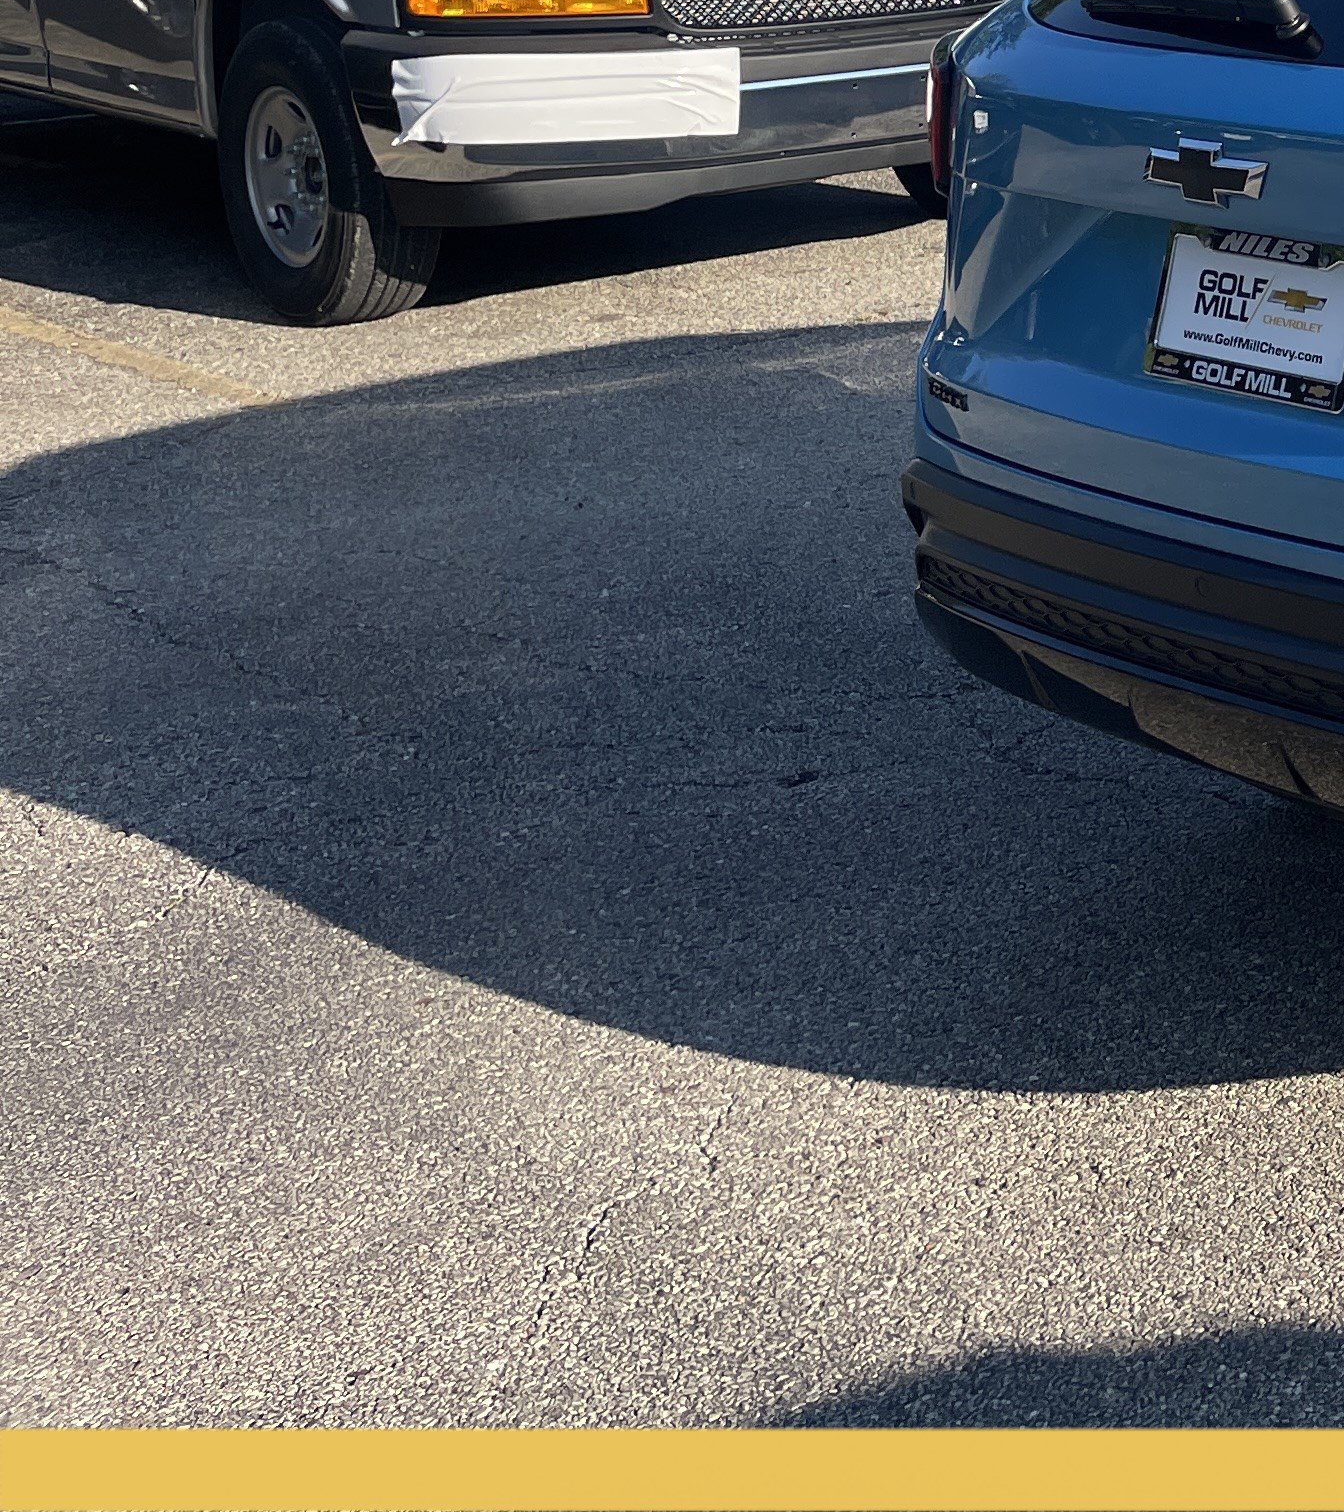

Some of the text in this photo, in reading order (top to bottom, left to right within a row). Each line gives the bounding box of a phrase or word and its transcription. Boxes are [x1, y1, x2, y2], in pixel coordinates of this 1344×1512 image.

[1219, 233, 1314, 263] NILES
[1199, 269, 1270, 300] GOLF
[1193, 292, 1250, 323] MILL
[1262, 314, 1324, 334] CHEVROLET
[1183, 329, 1324, 364] www.GolfMillChevy.com
[1191, 361, 1292, 399] GOLF MILL
